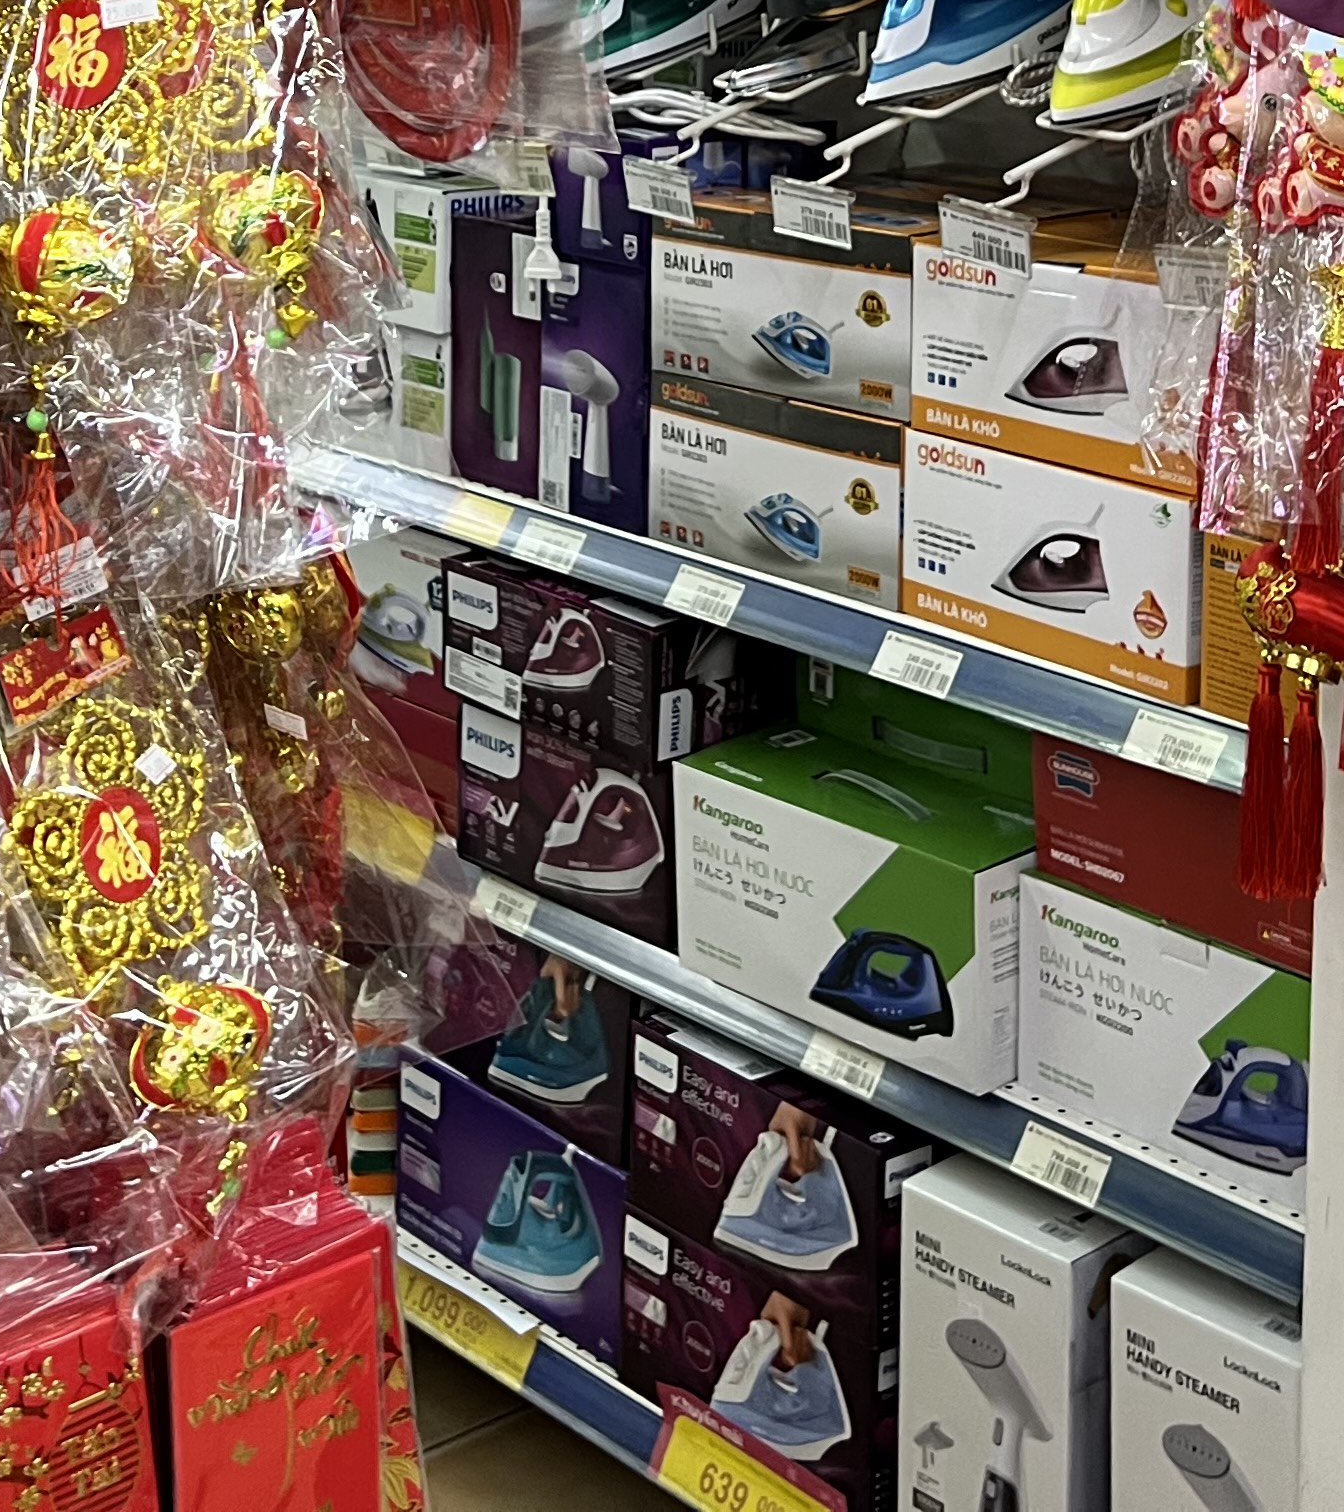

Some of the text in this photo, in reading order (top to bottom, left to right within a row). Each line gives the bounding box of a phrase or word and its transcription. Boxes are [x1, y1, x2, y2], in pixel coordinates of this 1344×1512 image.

[47, 14, 108, 89] 福
[664, 249, 733, 279] BÀN LÀ HƠI
[926, 256, 996, 287] goldsun
[661, 382, 710, 408] goldsun
[661, 422, 727, 456] BÀN LÀ HƠI
[926, 407, 1000, 438] BÀN LÀ KHÔ
[918, 441, 985, 476] goldsun
[452, 588, 493, 614] PHILIPS
[917, 592, 988, 628] BÀN LÀ KHÔ
[669, 695, 681, 752] PHILIPS
[467, 726, 515, 758] PHILIPS
[693, 795, 763, 836] Kangaroo
[96, 804, 153, 887] 福
[1040, 904, 1120, 948] Kangaroo
[683, 1065, 740, 1107] Easy and
[681, 1090, 734, 1127] effective
[915, 1229, 942, 1254] MINI
[673, 1246, 731, 1294] Easy and
[915, 1246, 1016, 1309] HANDY STEAMER
[672, 1271, 726, 1312] effective
[1126, 1328, 1155, 1355] MINI
[1126, 1345, 1241, 1414] HANDY STEAMER
